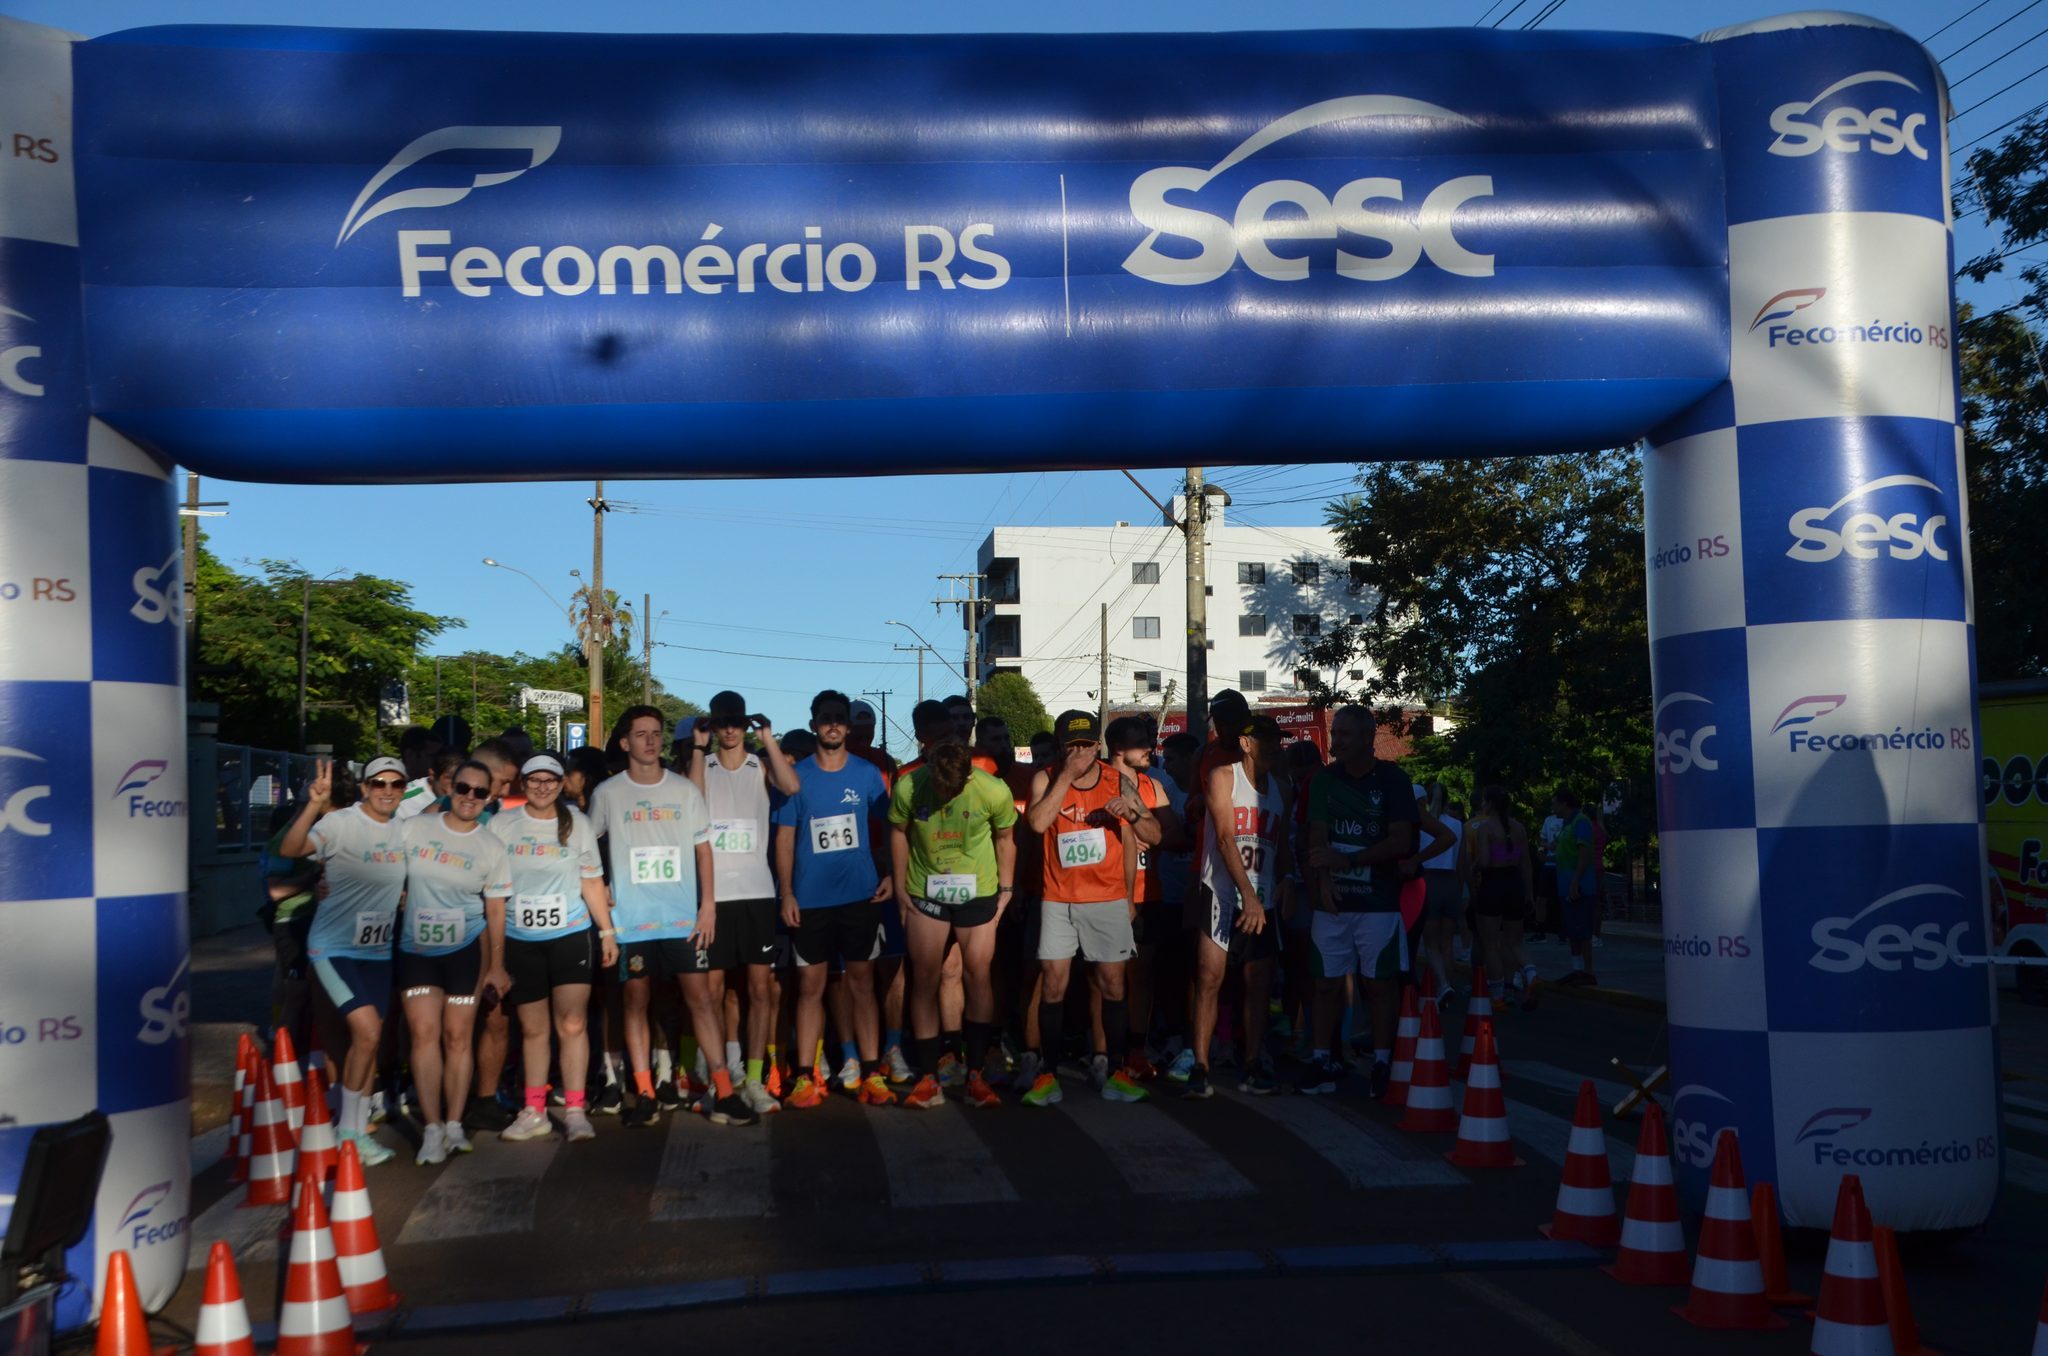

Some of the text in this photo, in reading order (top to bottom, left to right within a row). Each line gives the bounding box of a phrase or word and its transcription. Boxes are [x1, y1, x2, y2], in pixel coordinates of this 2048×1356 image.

[1767, 101, 1929, 161] Sesc
[13, 132, 60, 164] RS
[1121, 164, 1495, 287] Sesc
[397, 222, 1012, 298] Fecomércio RS
[1768, 319, 1950, 350] Fecomércio RS
[1697, 534, 1730, 560] RS
[1785, 506, 1949, 563] Sesc
[32, 577, 77, 602] RS
[1789, 727, 1971, 753] Fecomércio RS
[1065, 843, 1102, 864] 494
[637, 859, 675, 880] 516
[934, 886, 971, 903] 479
[522, 907, 561, 928] 855
[419, 923, 457, 944] 551
[1717, 935, 1752, 958] RS
[1807, 916, 1972, 974] Sesc
[37, 1015, 84, 1043] RS
[1813, 1135, 1998, 1167] Fecomércio RS
